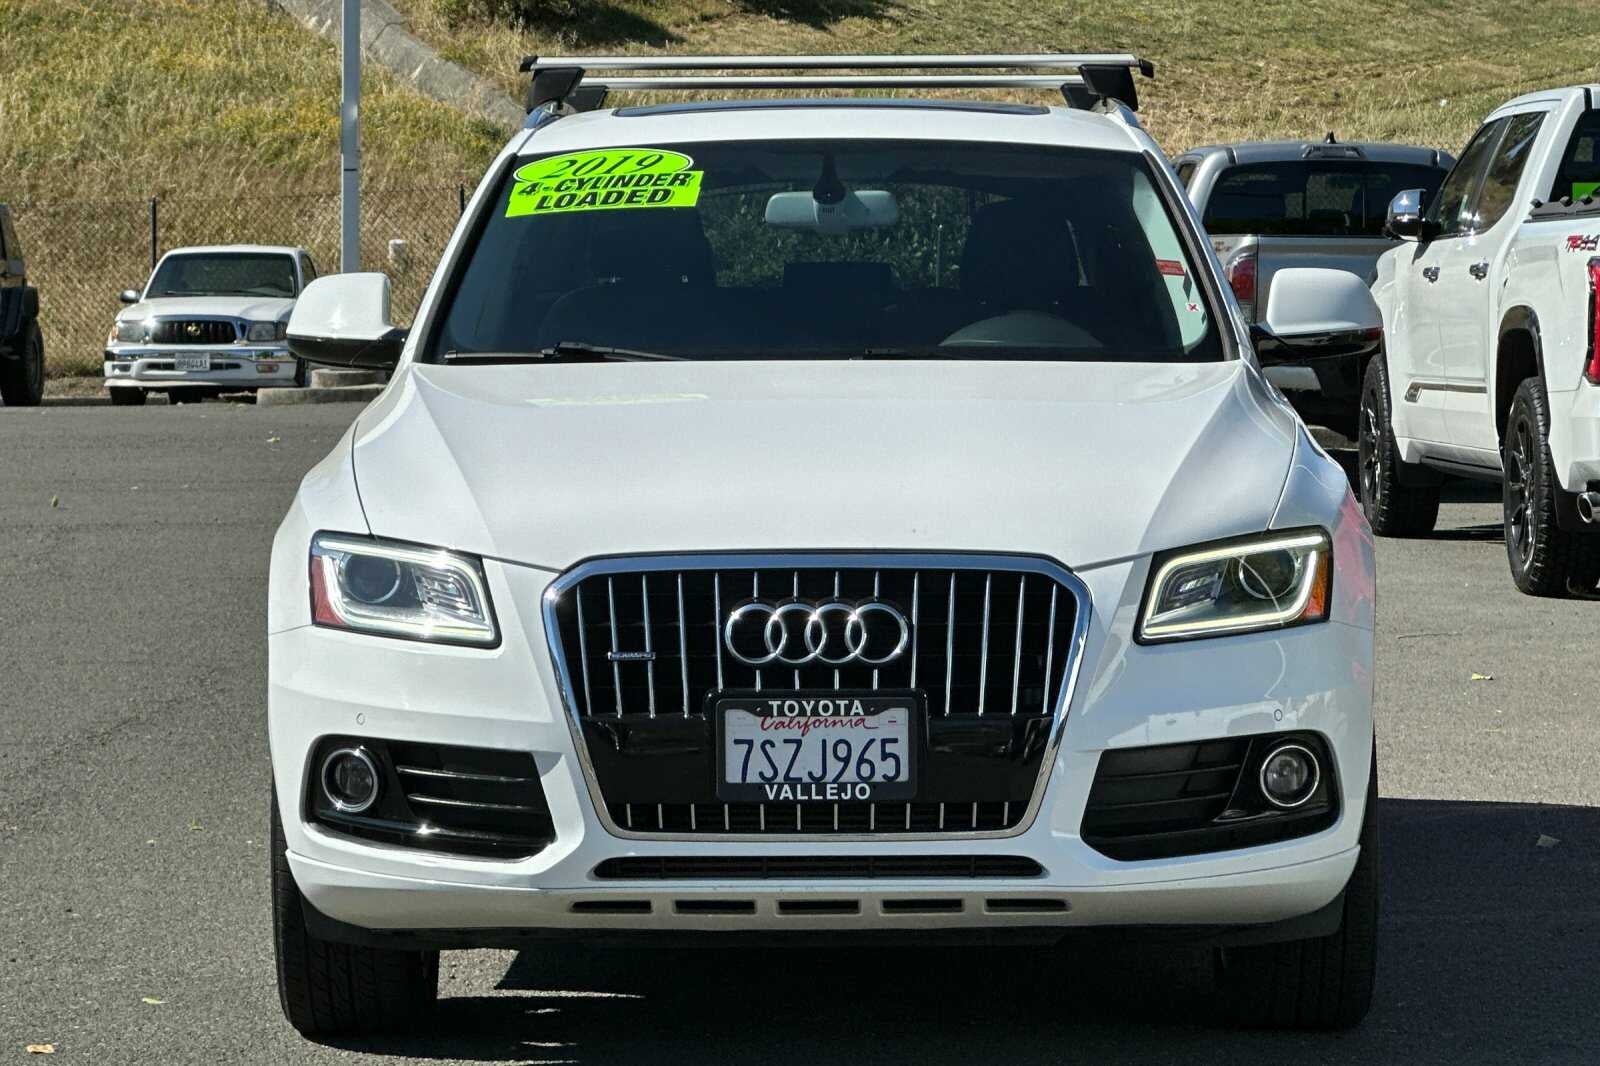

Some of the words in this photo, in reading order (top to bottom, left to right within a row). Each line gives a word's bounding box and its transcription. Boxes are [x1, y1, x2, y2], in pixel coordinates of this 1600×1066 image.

[542, 154, 664, 179] 2019
[518, 172, 693, 196] 4-CYLINDER
[535, 188, 674, 211] LOADED
[768, 700, 864, 717] TOYOTA
[760, 715, 879, 736] California
[733, 738, 900, 783] 7SZJ965
[765, 784, 870, 800] VALLEJO
